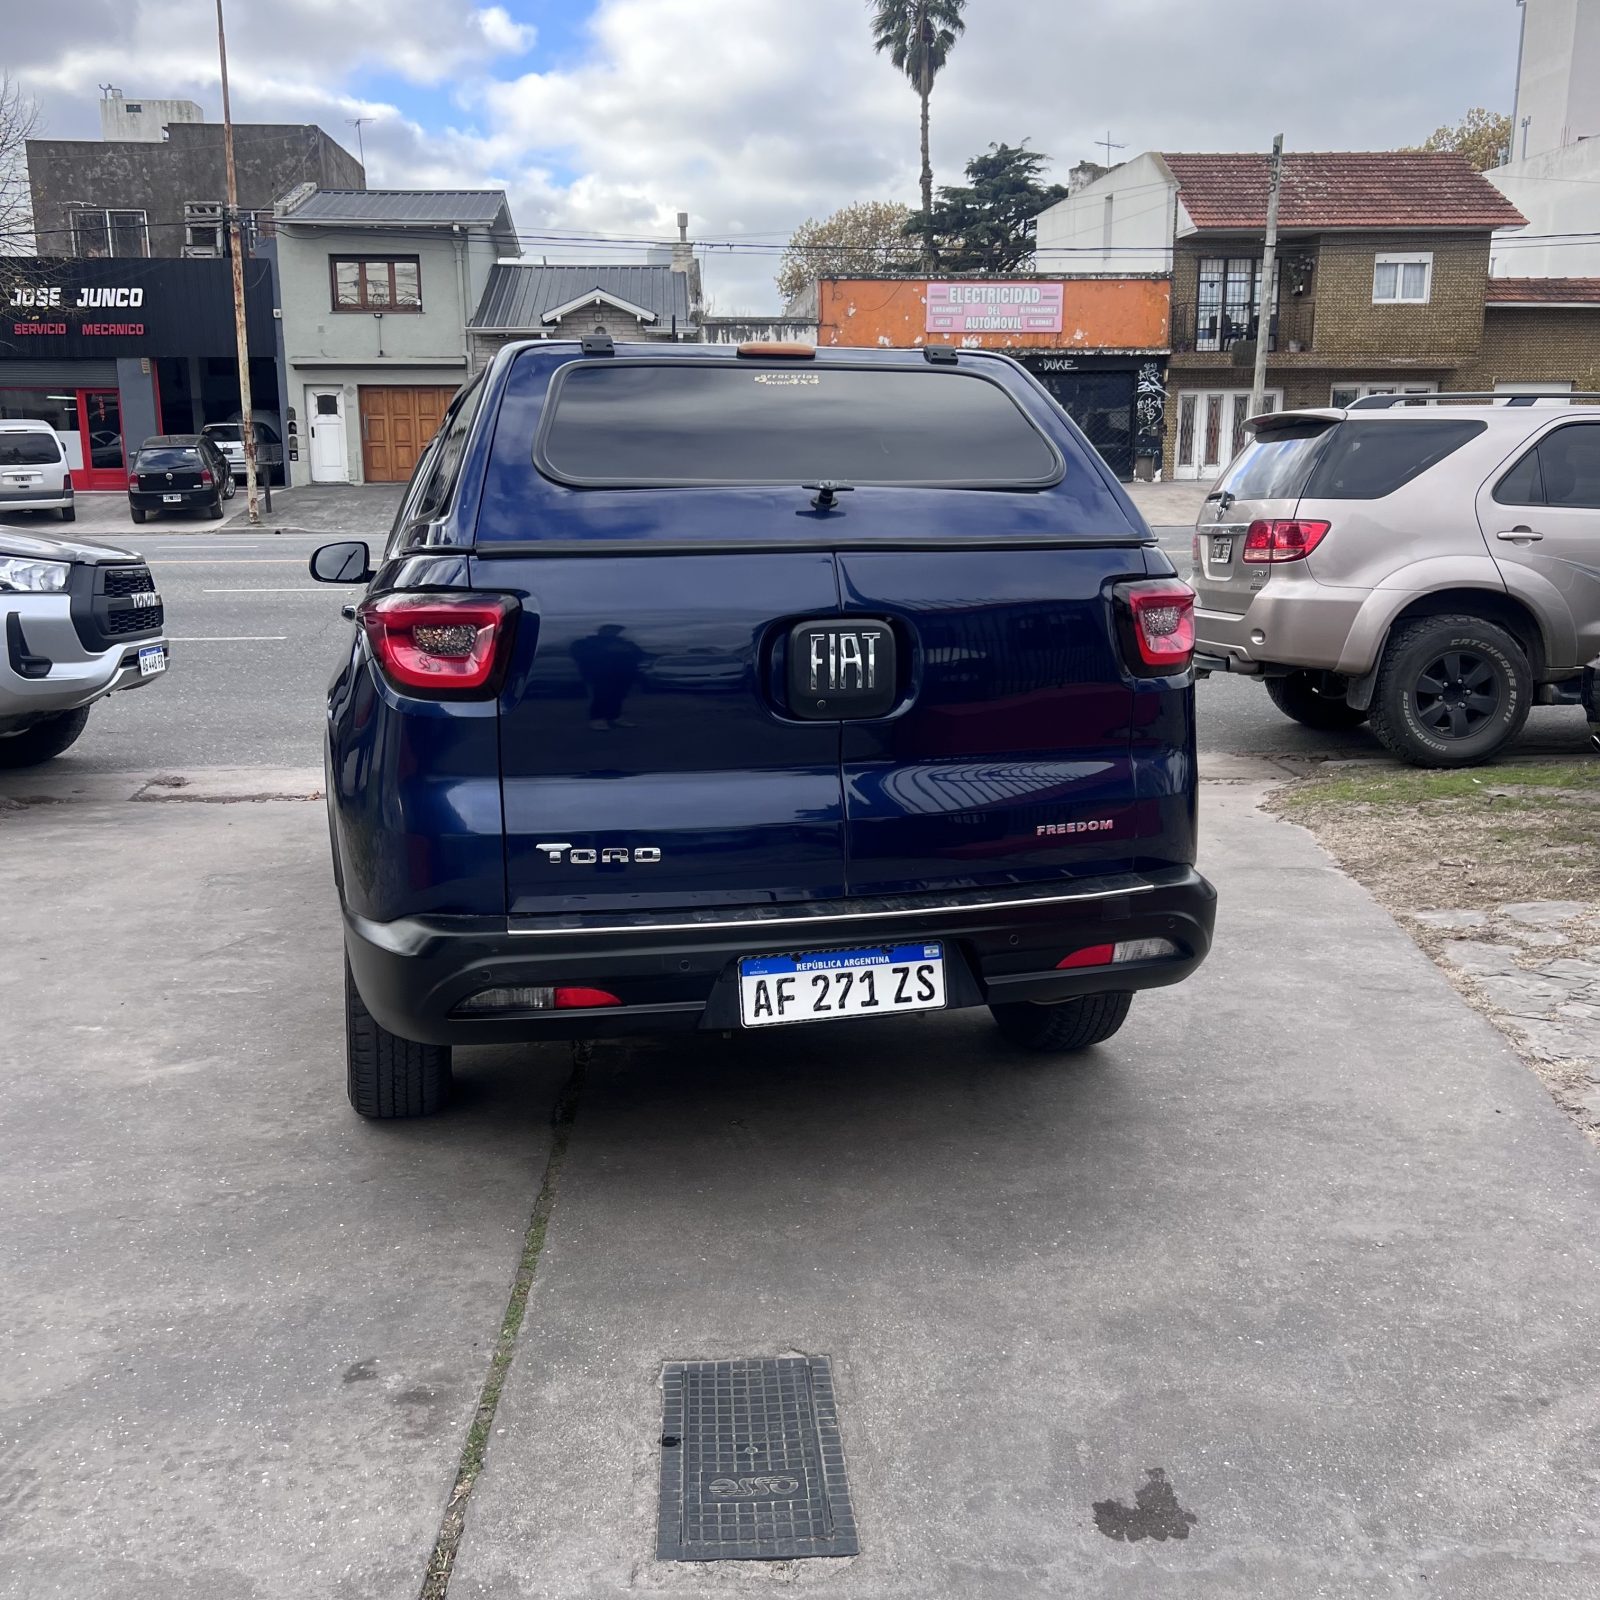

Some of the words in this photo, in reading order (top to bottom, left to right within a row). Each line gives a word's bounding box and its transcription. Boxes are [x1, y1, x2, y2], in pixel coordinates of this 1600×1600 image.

[10, 287, 61, 307] JOSE
[76, 287, 144, 308] JUNCO
[949, 287, 1041, 304] ELECTRICIDAD
[987, 306, 1001, 315] DEL
[14, 323, 67, 335] SERVICIO
[82, 323, 145, 335] MECANICO
[965, 316, 1023, 330] AUTOMOVIL
[1042, 358, 1079, 371] DUKE
[810, 632, 881, 690] FIAT
[1036, 819, 1113, 836] FREEDOM
[535, 843, 661, 863] TORO
[796, 960, 842, 972] REPÚBLICA
[844, 955, 890, 967] ARGENTINA
[753, 979, 796, 1018] AF
[811, 970, 880, 1012] 271
[892, 964, 936, 1004] ZS
